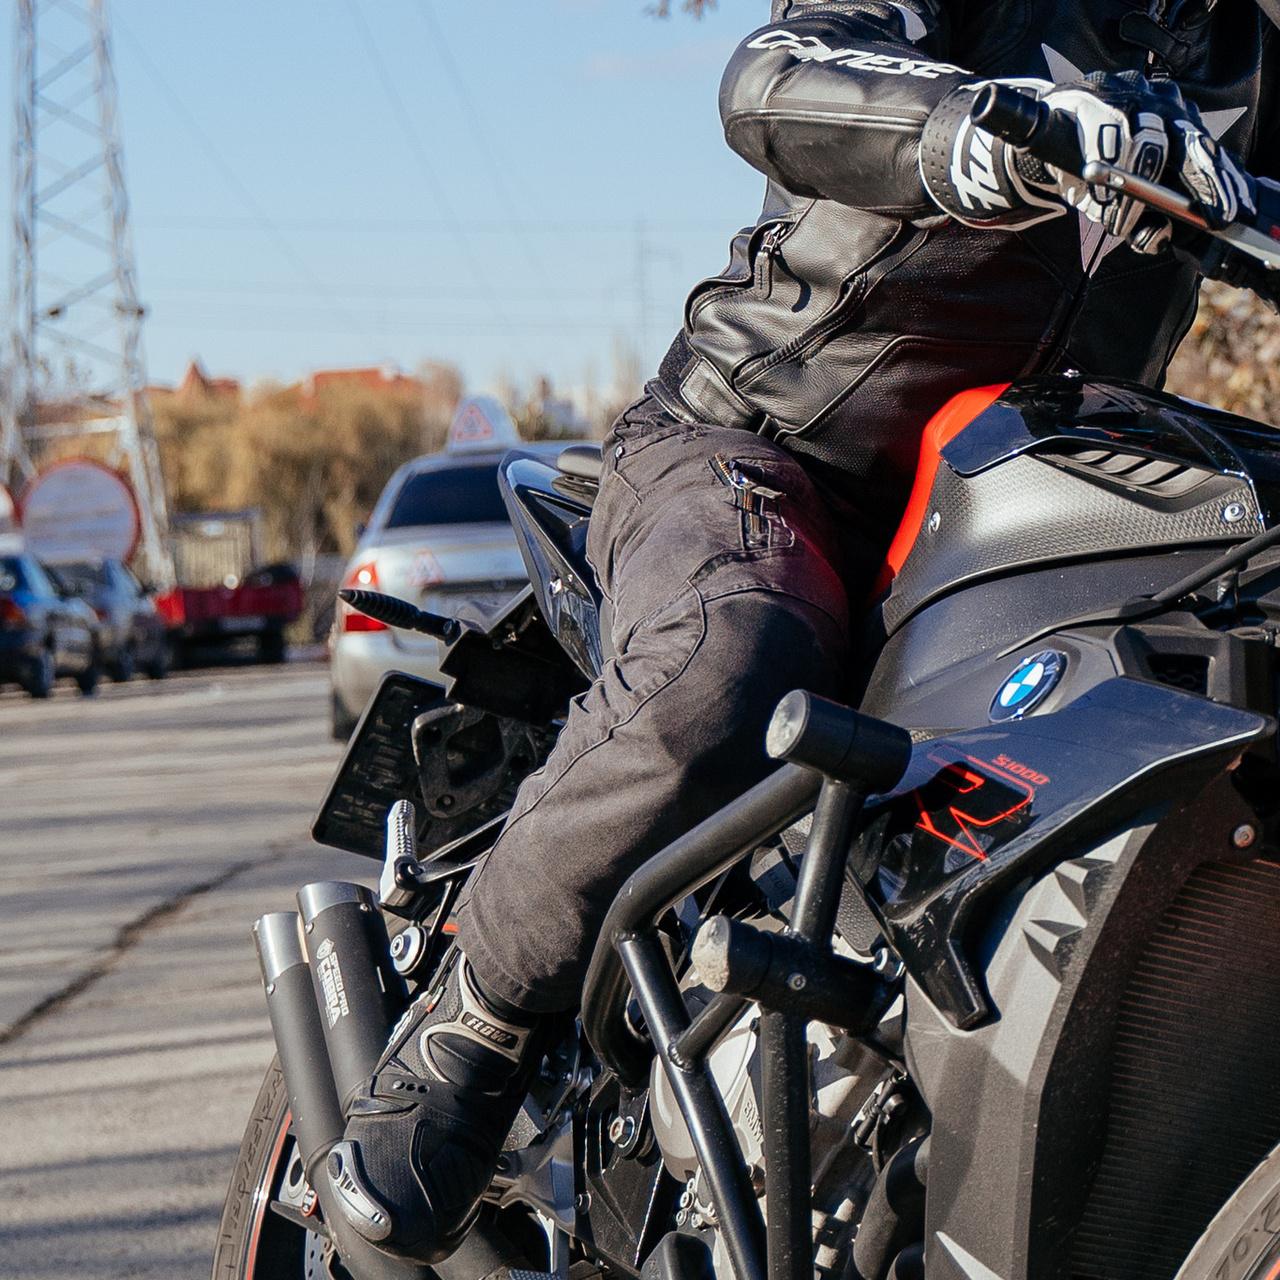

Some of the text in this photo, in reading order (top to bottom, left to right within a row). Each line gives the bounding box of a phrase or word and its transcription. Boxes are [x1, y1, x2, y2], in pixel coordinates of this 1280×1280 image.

[992, 754, 1050, 785] S1000
[320, 956, 341, 1028] COBRA
[329, 951, 344, 993] SPEED
[338, 990, 350, 1017] PRO
[466, 1017, 511, 1043] FLOW
